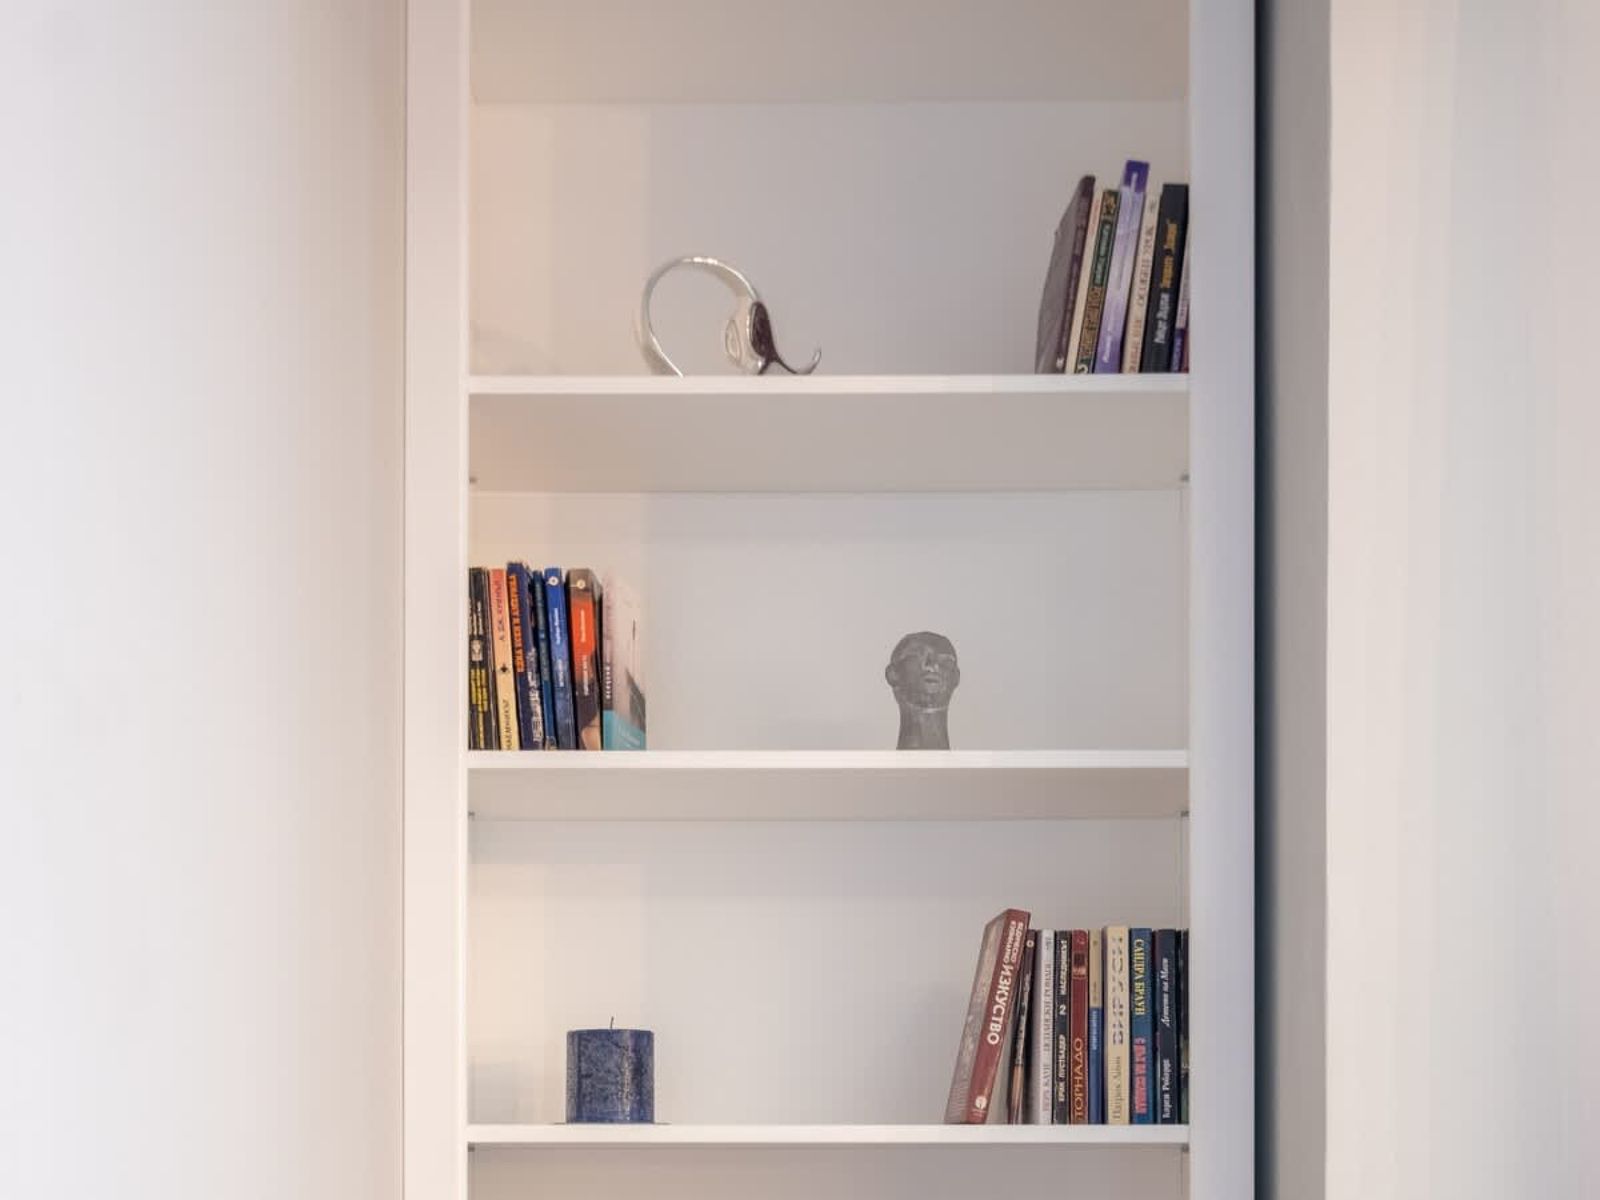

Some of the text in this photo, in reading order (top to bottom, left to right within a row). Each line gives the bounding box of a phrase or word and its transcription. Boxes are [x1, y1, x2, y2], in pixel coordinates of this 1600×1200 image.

[987, 964, 1014, 1045] ИЗКУСТВО
[1134, 939, 1145, 1016] САНДРА БРАУН
[1074, 1037, 1084, 1120] ТОРНАДО
